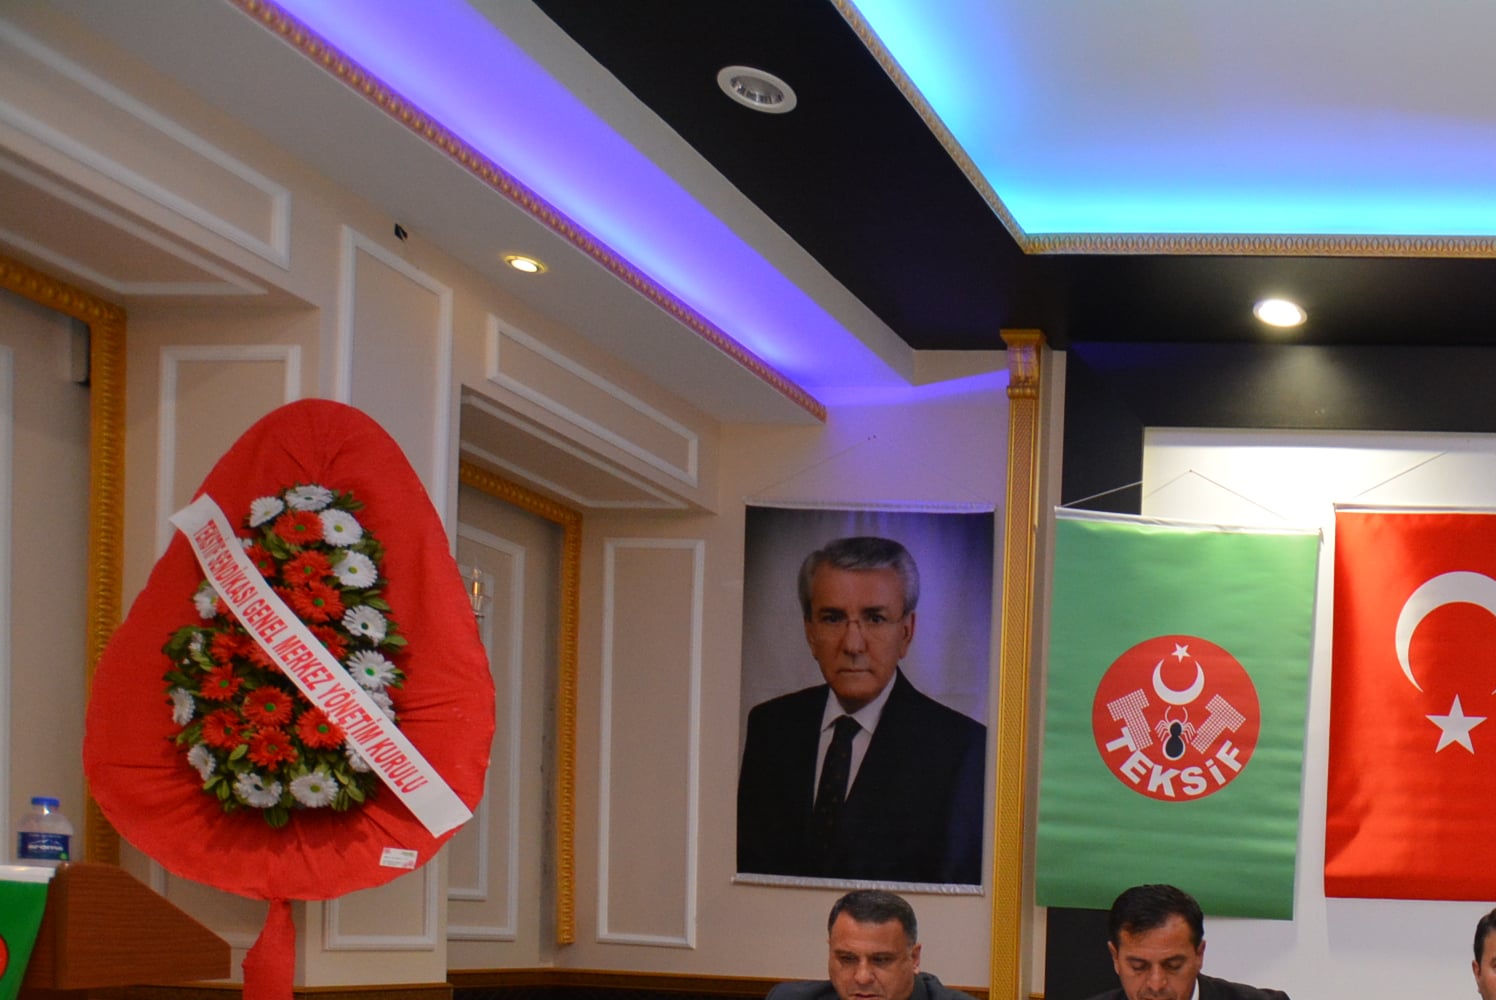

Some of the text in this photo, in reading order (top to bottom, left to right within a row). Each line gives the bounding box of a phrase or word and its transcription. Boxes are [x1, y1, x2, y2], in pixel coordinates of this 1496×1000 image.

[207, 549, 259, 608] SENDİKASI
[242, 598, 289, 645] GENEL
[272, 634, 335, 692] MERKEZ
[317, 682, 385, 746] YÖNETİM
[365, 737, 429, 793] KURULU
